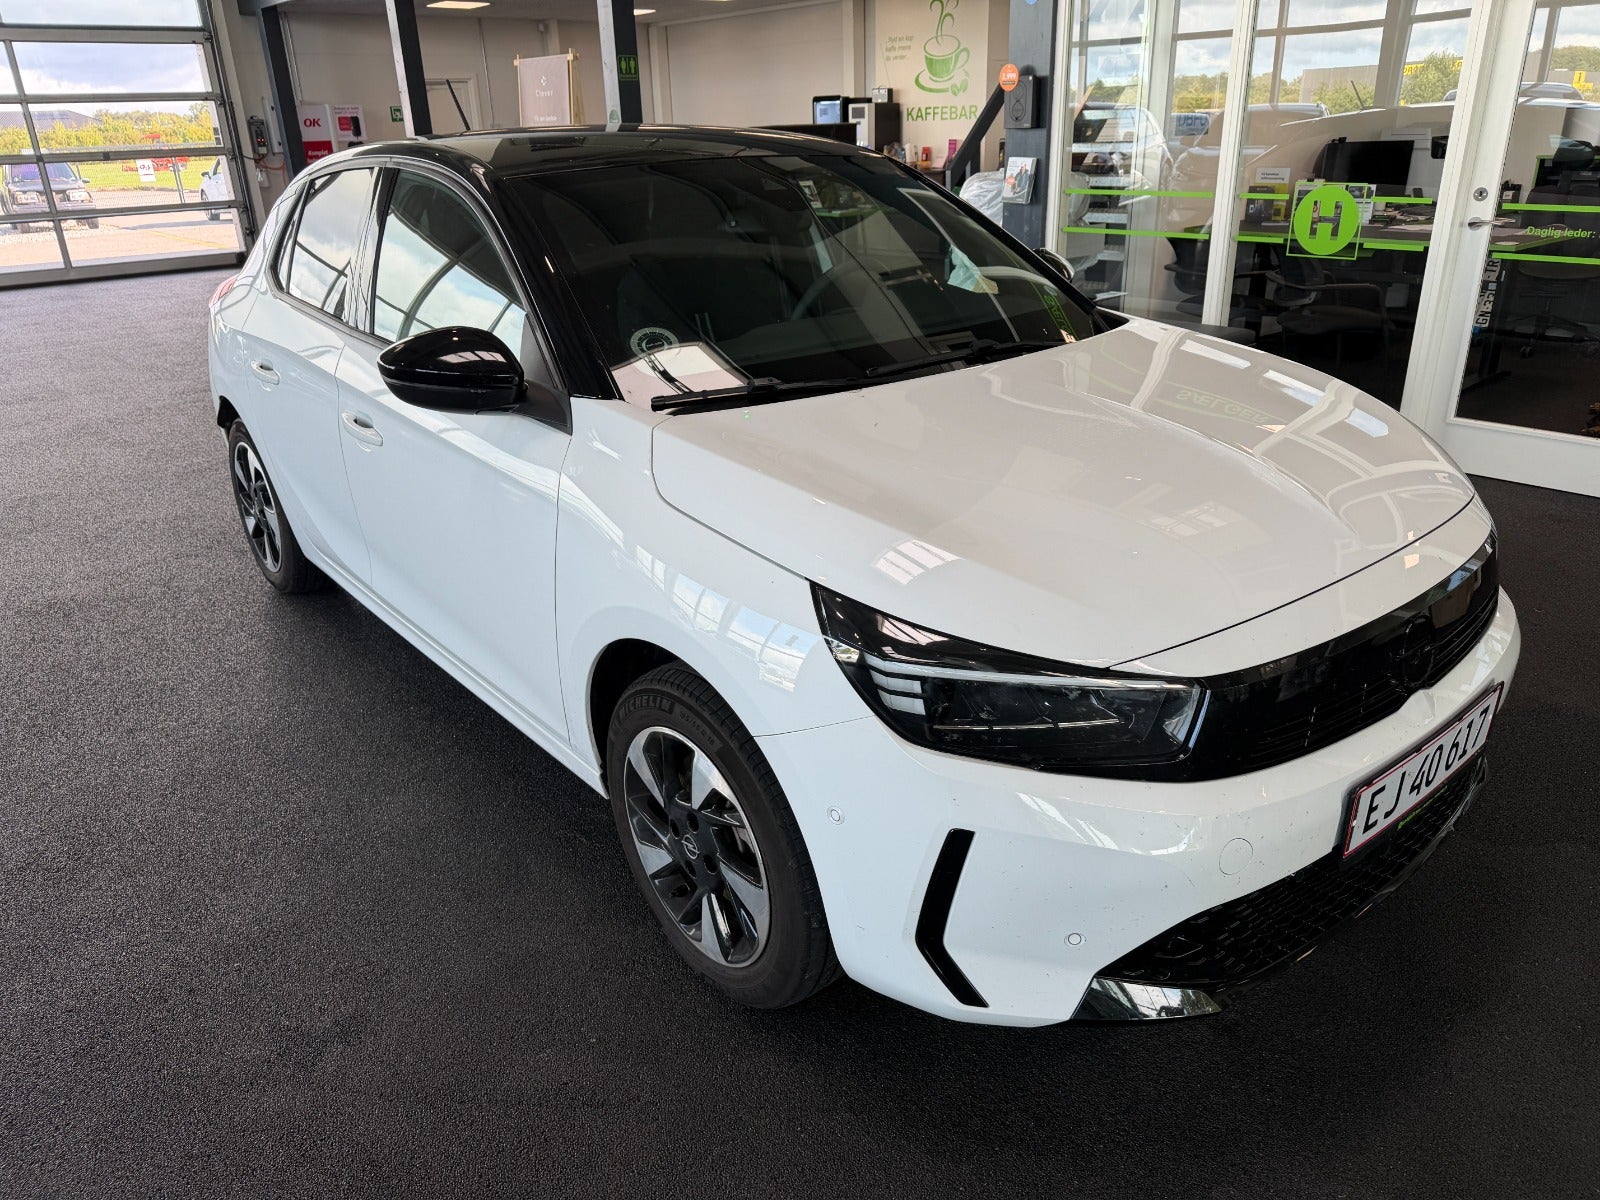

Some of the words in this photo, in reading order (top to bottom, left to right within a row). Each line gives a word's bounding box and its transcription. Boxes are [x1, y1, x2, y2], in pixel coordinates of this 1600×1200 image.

[906, 105, 978, 121] KAFFEBAR
[303, 118, 322, 128] OK
[1527, 226, 1561, 238] Daglig
[1563, 228, 1596, 239] leder:
[619, 695, 673, 720] MICHELIN
[1362, 770, 1407, 835] EJ
[1408, 743, 1444, 797] 40
[1444, 703, 1491, 772] 617
